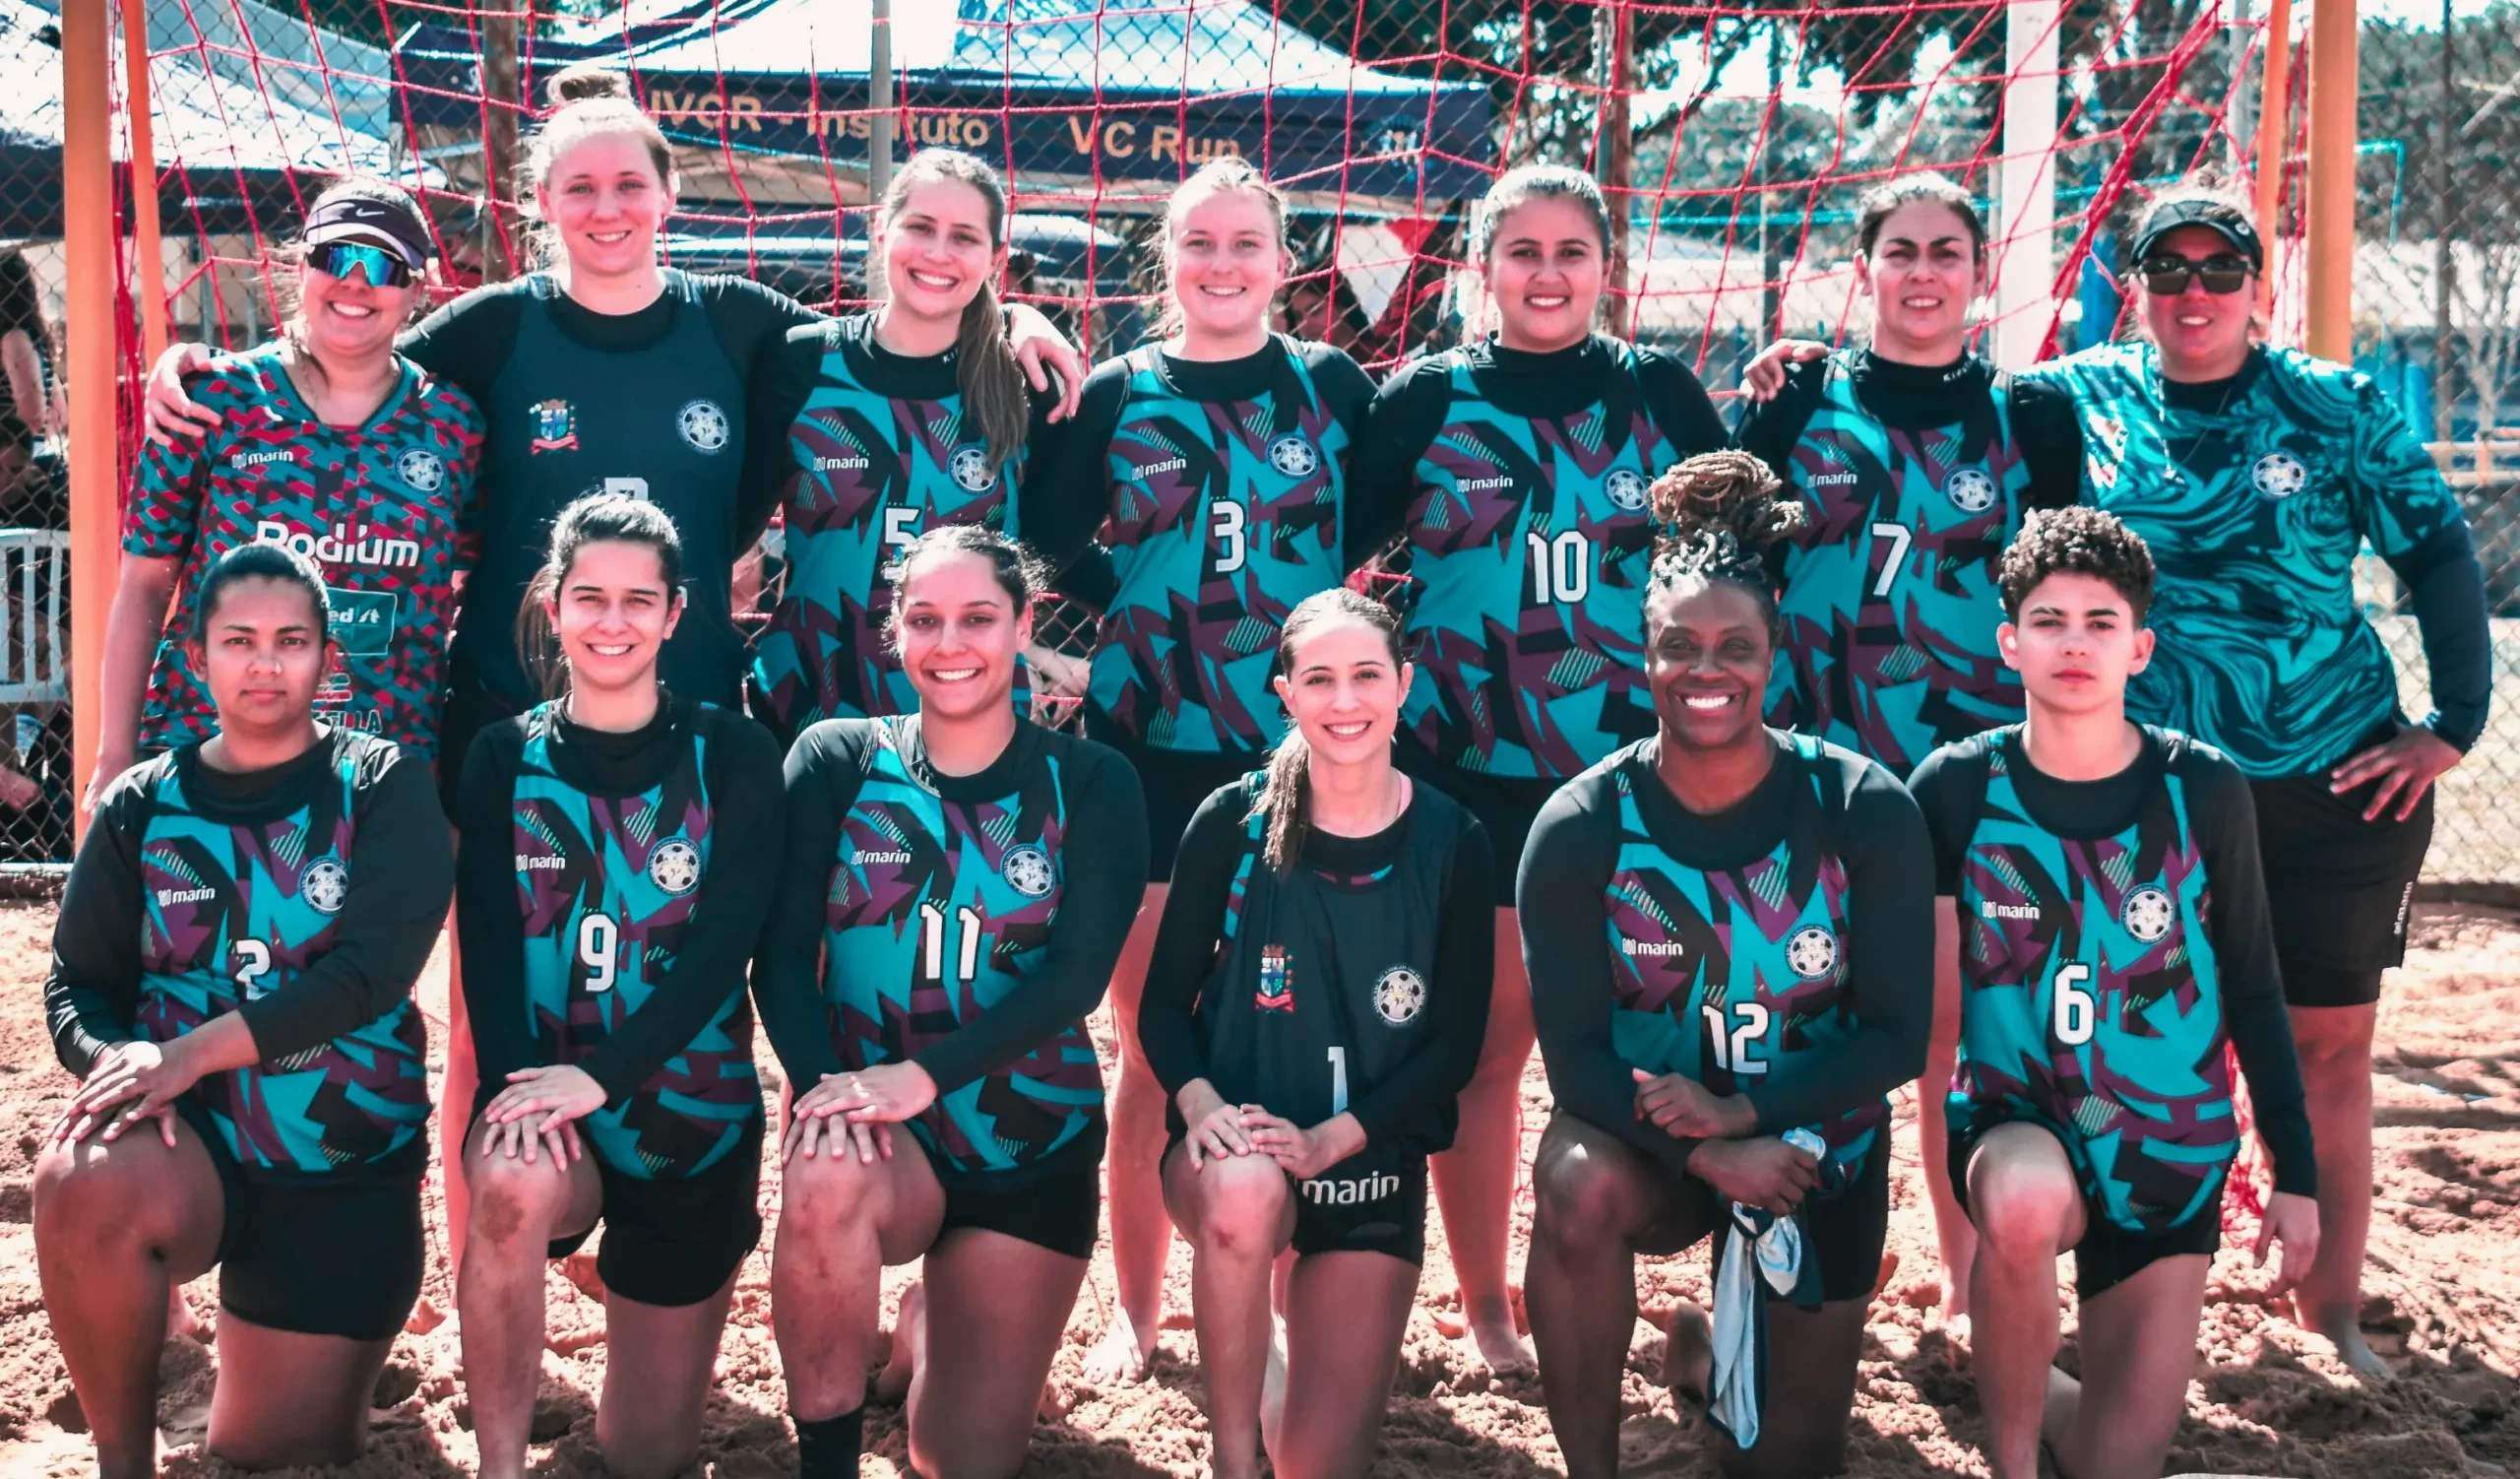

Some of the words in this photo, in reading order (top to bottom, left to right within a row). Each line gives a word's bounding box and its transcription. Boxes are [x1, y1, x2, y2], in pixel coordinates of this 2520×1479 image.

[807, 98, 989, 147] Insituto
[1068, 115, 1136, 158] VC
[1152, 125, 1239, 164] Run
[248, 449, 294, 465] marin
[827, 454, 869, 470] marin
[1145, 456, 1187, 477] marin
[1471, 475, 1513, 490] marin
[1815, 470, 1858, 486] marin
[885, 507, 920, 580] 5
[1212, 500, 1245, 573] 3
[1527, 530, 1589, 604] 10
[1872, 523, 1912, 597] 7
[864, 849, 912, 865] marin
[172, 885, 216, 904] marin
[1997, 903, 2041, 920] marin
[235, 938, 271, 1000] 2
[580, 914, 617, 992] 9
[920, 903, 981, 980] 11
[1637, 939, 1683, 956] marin
[2054, 964, 2095, 1045] 6
[1702, 1002, 1769, 1073] 12
[1327, 1046, 1348, 1117] 1
[1302, 1170, 1400, 1204] marin
